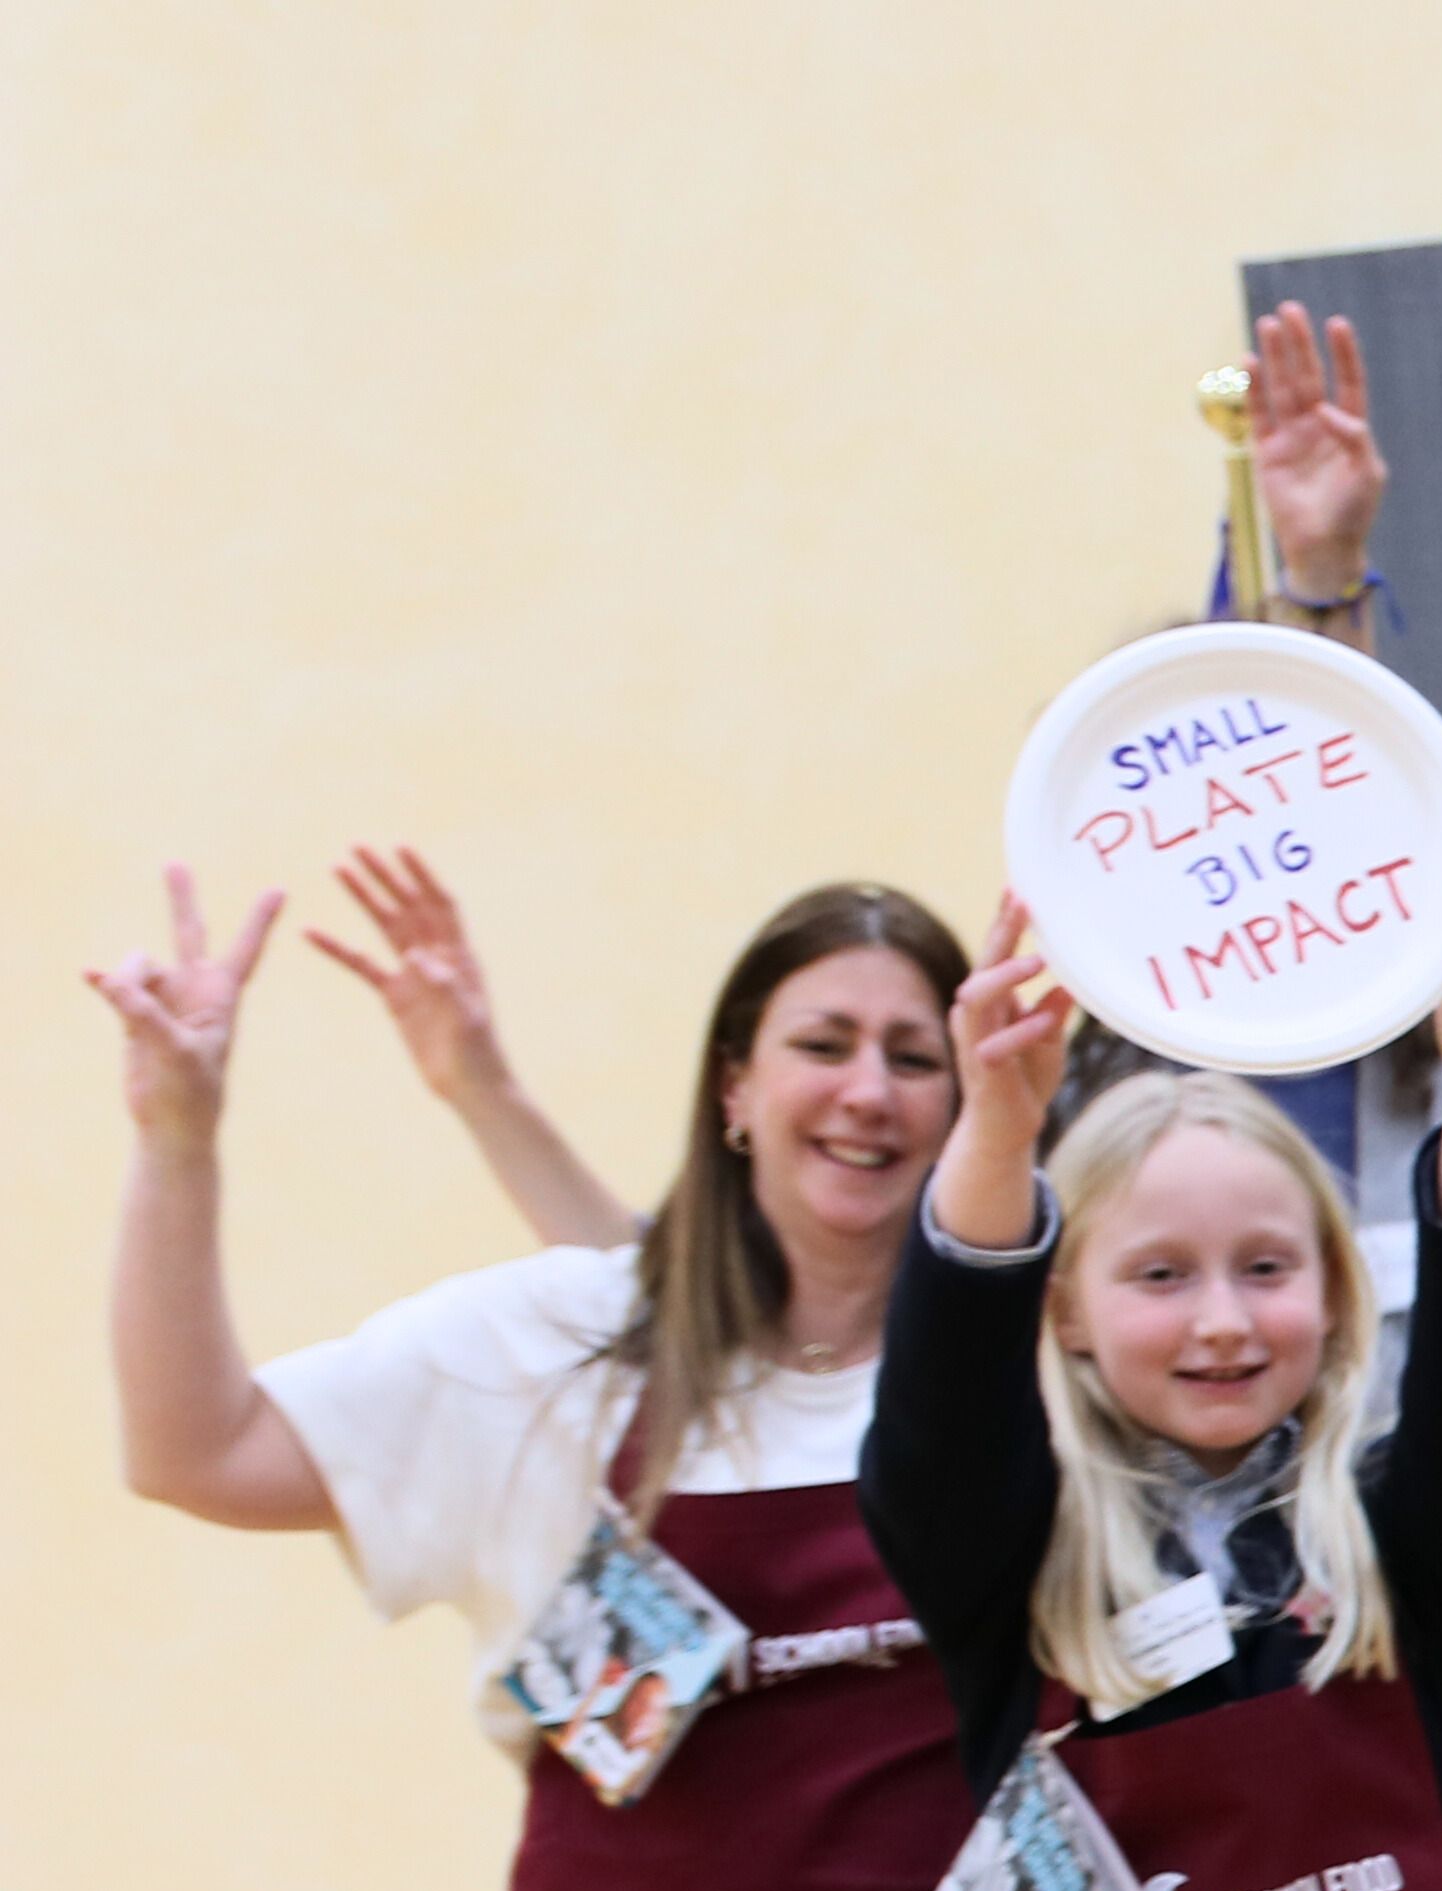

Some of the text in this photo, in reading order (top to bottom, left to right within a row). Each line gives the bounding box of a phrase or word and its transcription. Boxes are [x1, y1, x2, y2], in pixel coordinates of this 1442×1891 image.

[1073, 733, 1368, 872] PLATE
[1111, 700, 1288, 791] SMALL
[1185, 830, 1313, 906] BIG
[1148, 857, 1413, 1011] IMPACT
